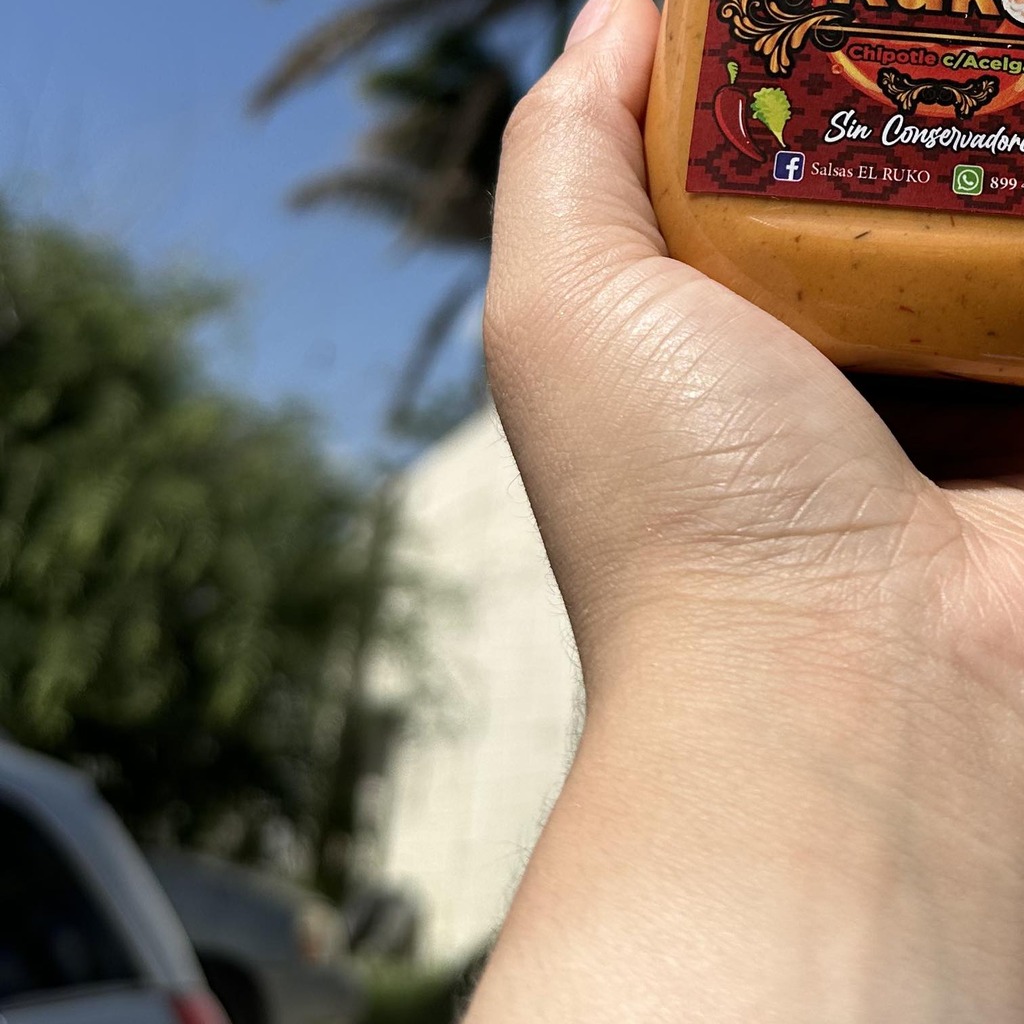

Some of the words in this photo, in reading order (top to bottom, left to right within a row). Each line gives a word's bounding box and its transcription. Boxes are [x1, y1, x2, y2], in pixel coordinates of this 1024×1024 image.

[849, 45, 936, 66] Chipotle
[824, 109, 872, 143] Sin
[811, 161, 854, 178] Salsas
[858, 165, 878, 180] EL
[882, 167, 931, 184] RUKO
[989, 176, 1018, 190] 899
